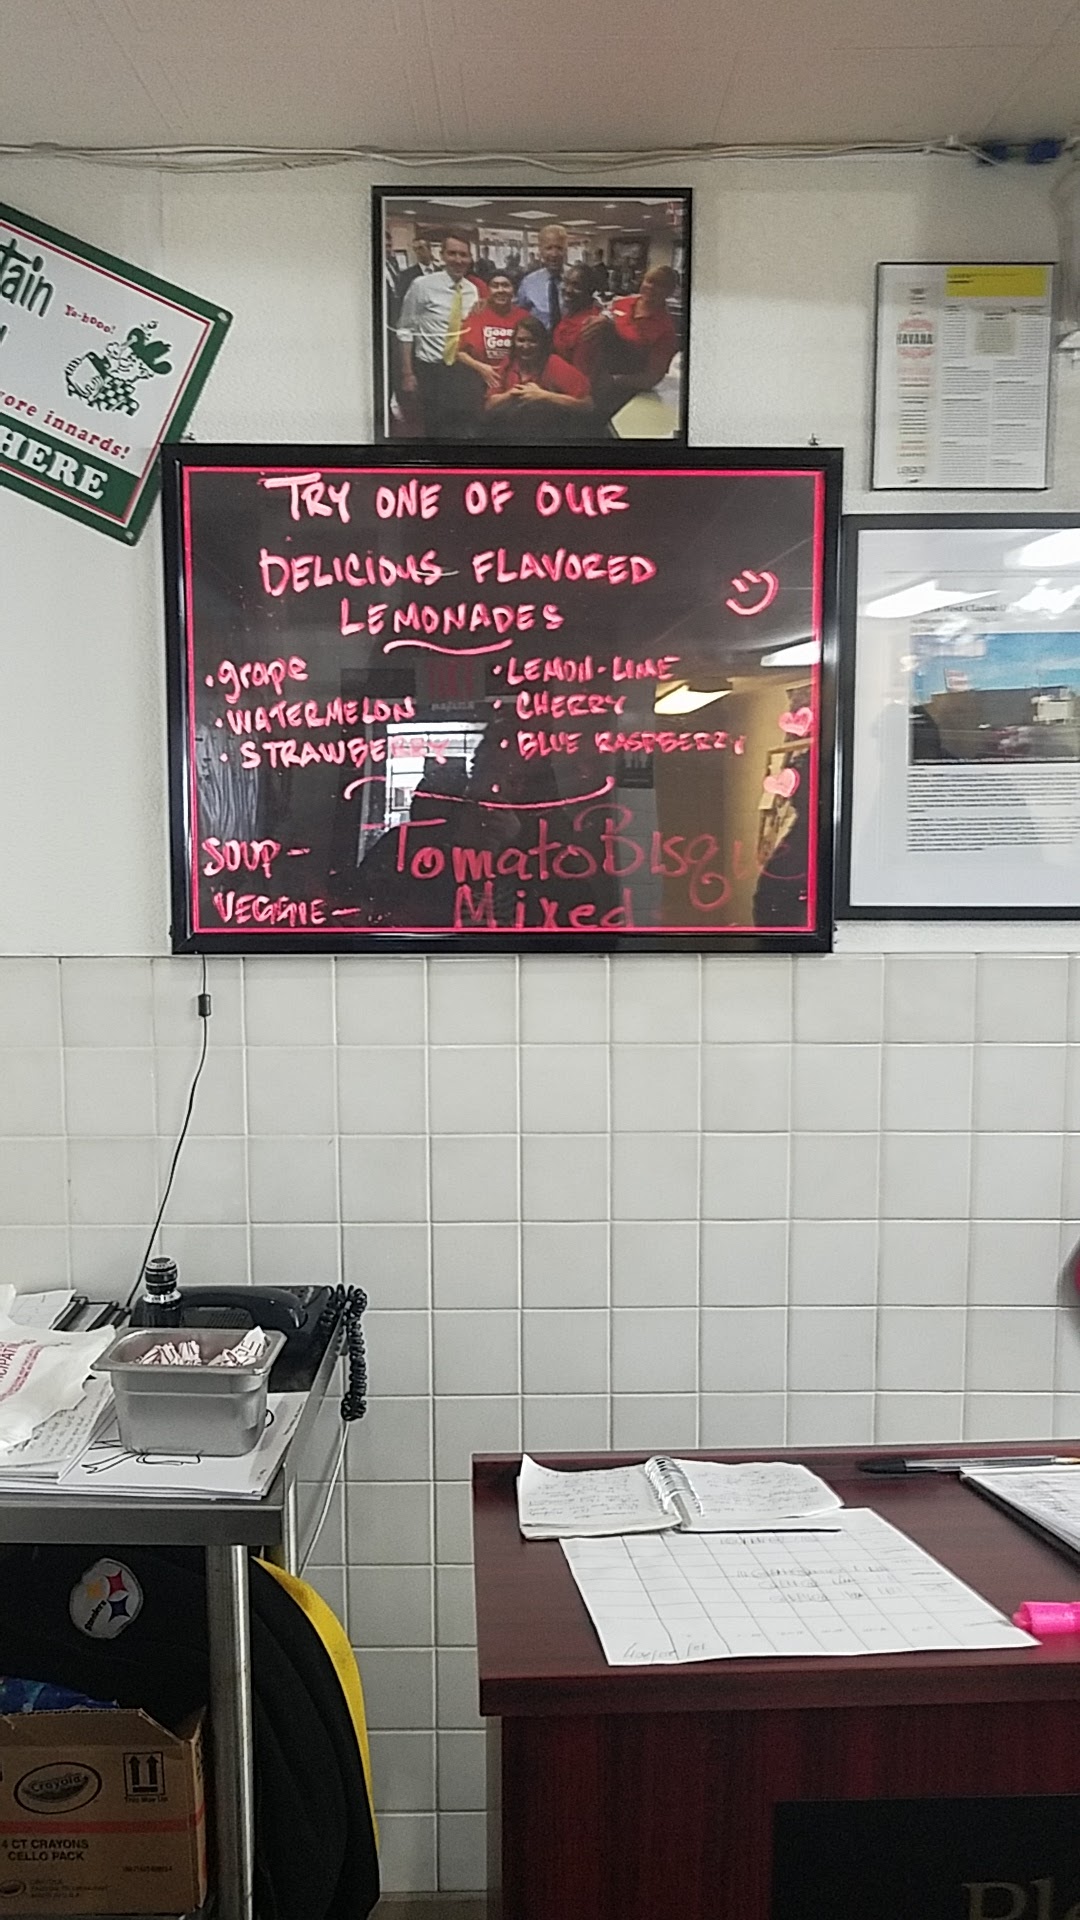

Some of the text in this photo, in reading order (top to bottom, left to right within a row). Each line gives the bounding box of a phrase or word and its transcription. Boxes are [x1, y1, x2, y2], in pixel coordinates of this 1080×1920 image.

[0, 389, 130, 460] ore innards!
[262, 472, 630, 523] TRY ONE OF OUR
[259, 547, 657, 596] DELICIOUS FLAVORED
[340, 598, 565, 636] LEMONADES
[217, 656, 309, 701] grape
[226, 696, 416, 736] WATERMELON
[515, 692, 627, 719] CHERRY
[240, 738, 449, 770] STRAWBERRY
[517, 730, 585, 760] BLUE
[363, 815, 594, 884] Tomato
[455, 880, 633, 929] Mixed
[30, 1774, 82, 1793] Crayola
[8, 1851, 85, 1861] CELLO PACK
[12, 1840, 27, 1849] CT
[31, 1840, 89, 1849] CRAYONS
